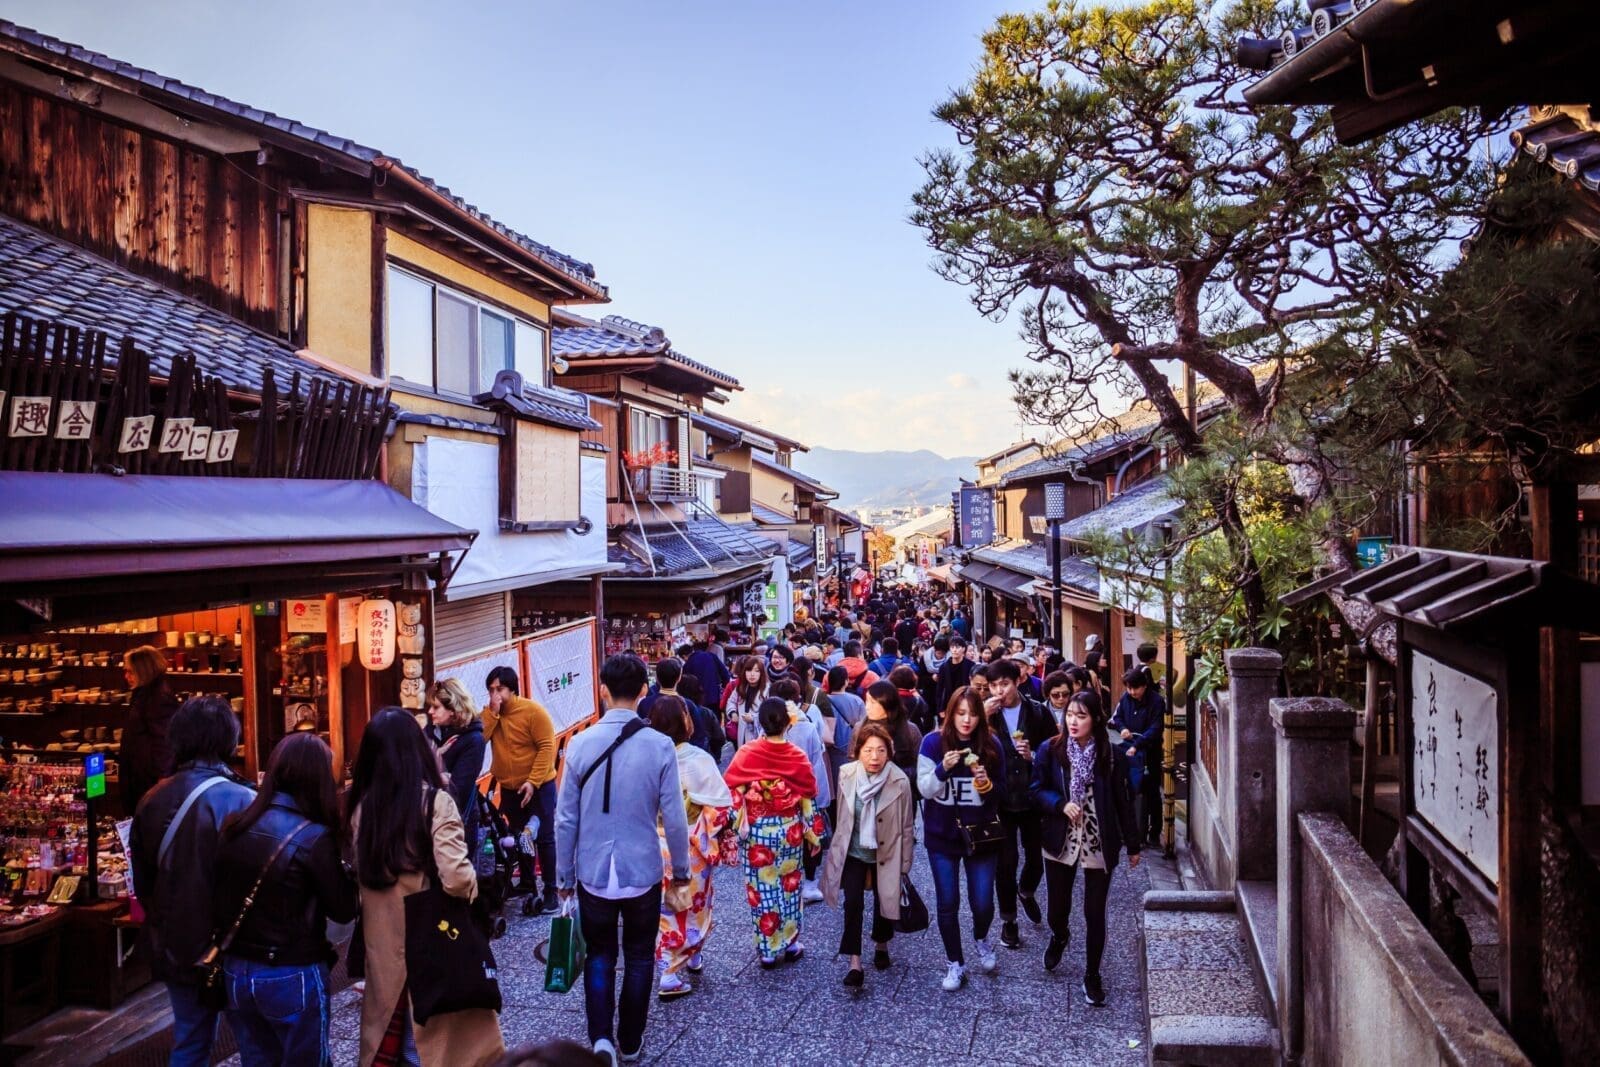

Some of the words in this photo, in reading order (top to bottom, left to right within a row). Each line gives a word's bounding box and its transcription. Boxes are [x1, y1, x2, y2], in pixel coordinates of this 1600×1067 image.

[126, 421, 229, 458] なかにし
[370, 610, 384, 665] 夜の特別拝観
